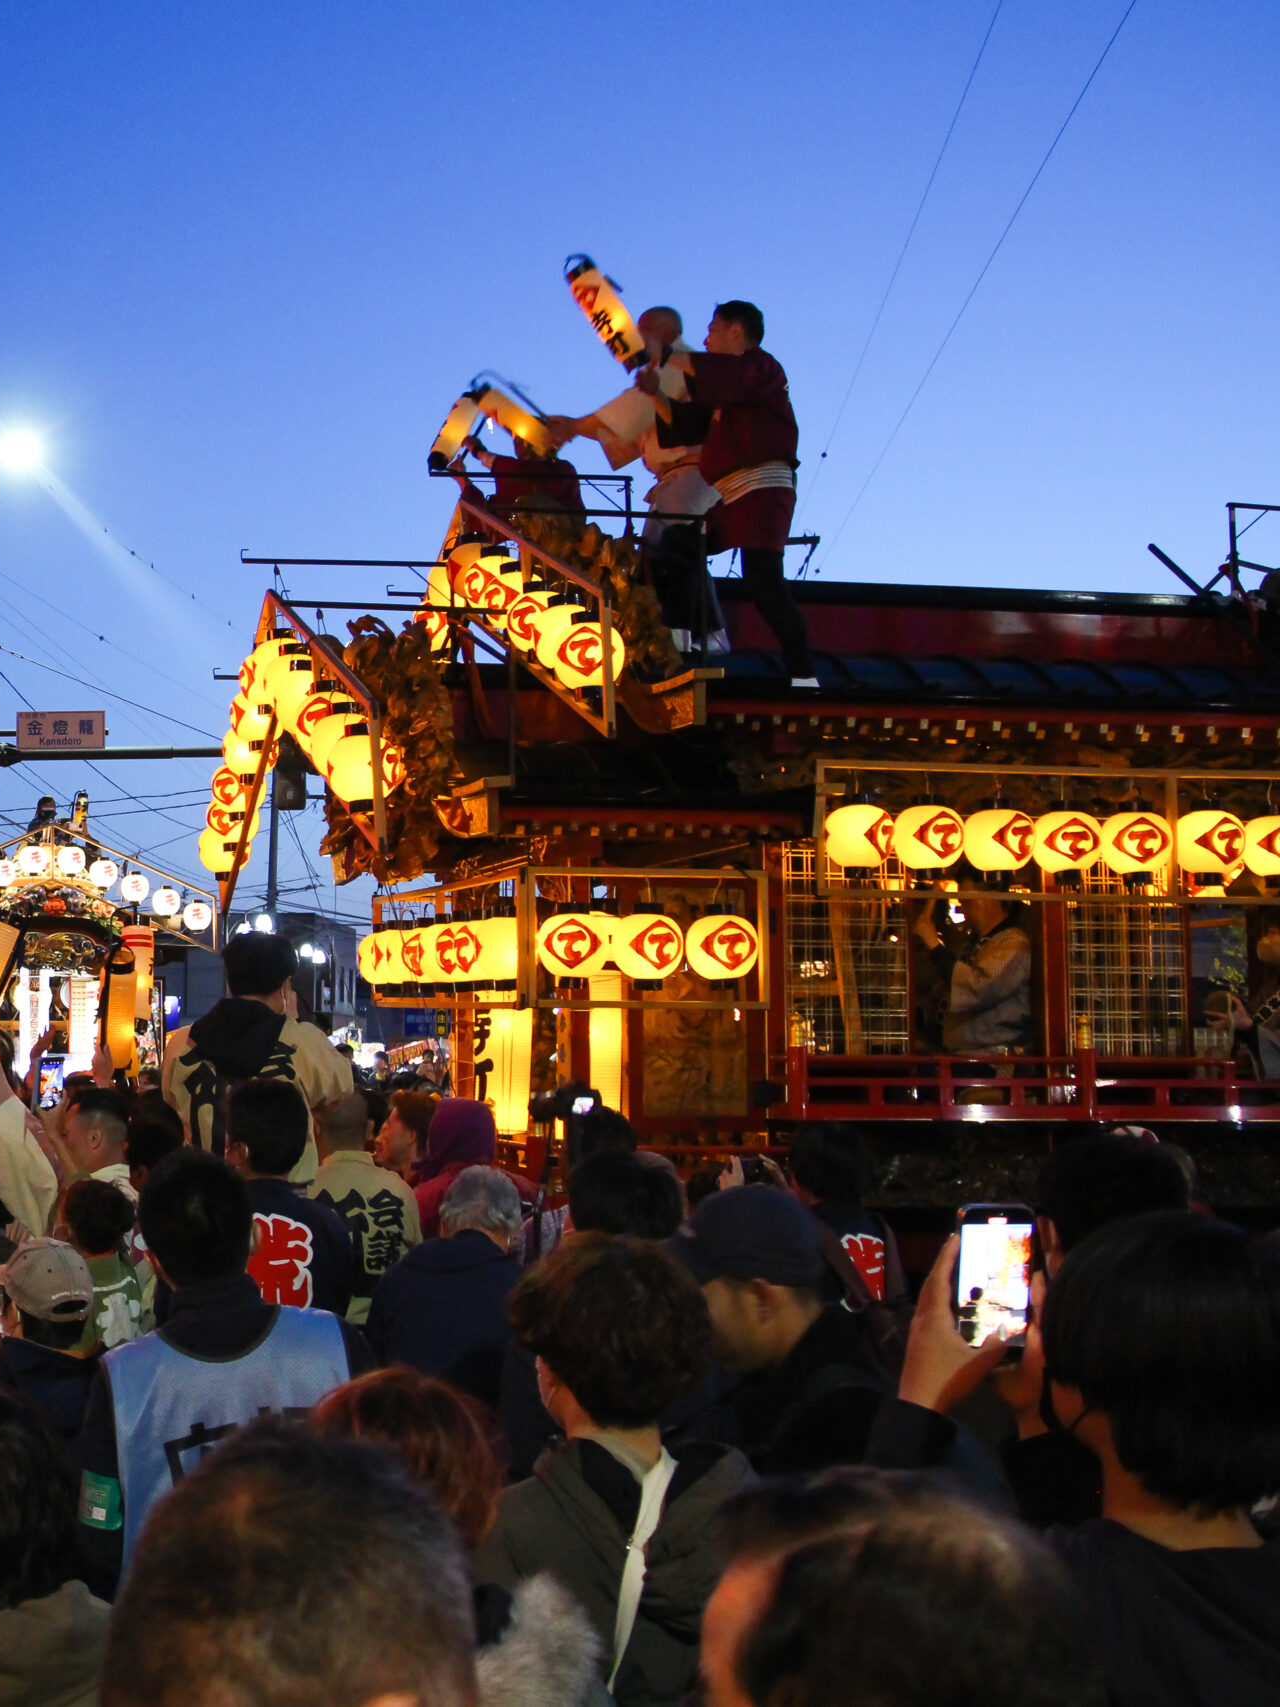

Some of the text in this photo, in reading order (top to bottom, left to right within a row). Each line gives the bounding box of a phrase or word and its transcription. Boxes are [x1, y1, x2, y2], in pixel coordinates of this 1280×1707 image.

[39, 737, 81, 745] Kanadoro
[30, 851, 41, 863] 元
[72, 852, 81, 864] 元
[1, 865, 12, 876] 元
[104, 865, 114, 877] 元
[131, 880, 142, 892] 元
[165, 895, 176, 906] 元
[192, 908, 203, 920] 元
